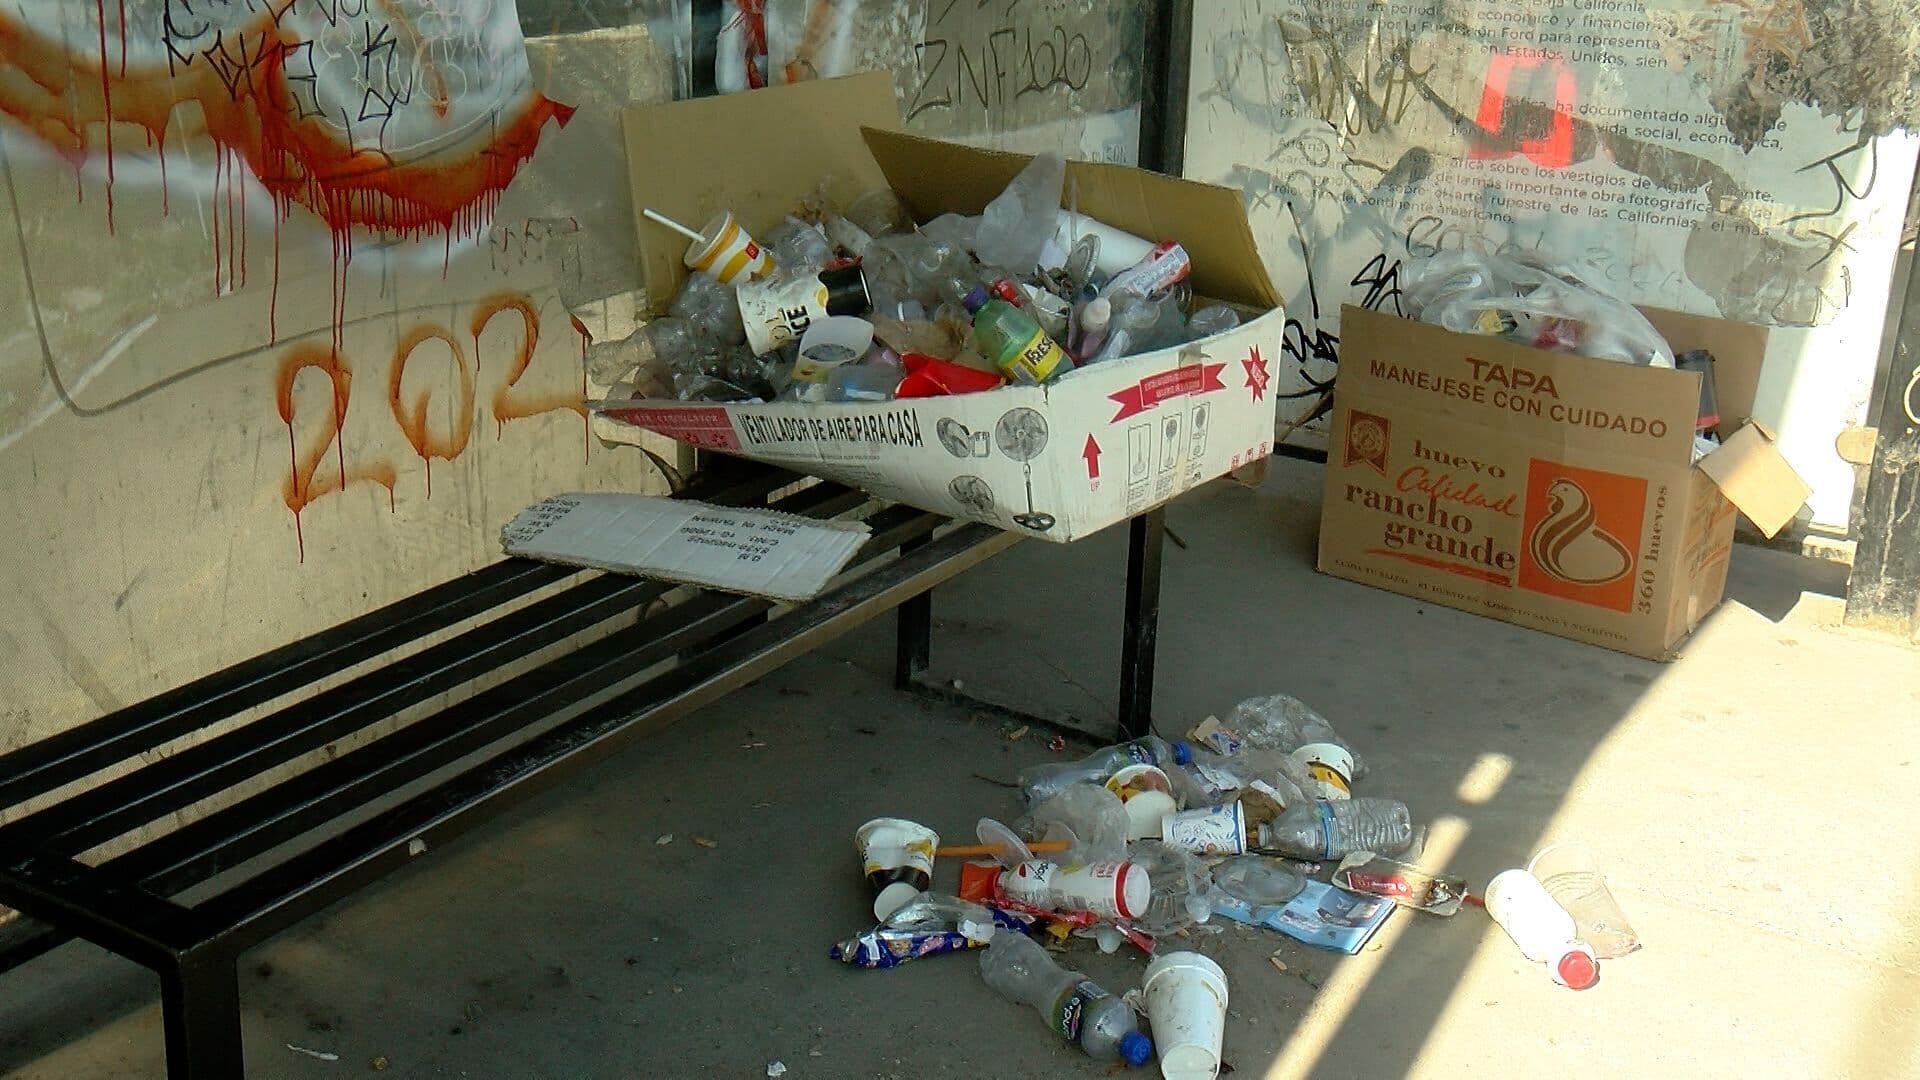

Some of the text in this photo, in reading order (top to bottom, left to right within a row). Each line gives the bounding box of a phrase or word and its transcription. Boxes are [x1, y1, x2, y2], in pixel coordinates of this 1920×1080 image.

[1567, 16, 1576, 28] y
[1573, 0, 1647, 13] California
[1501, 26, 1534, 40] Ford
[1538, 31, 1572, 45] para
[1480, 44, 1498, 54] en
[1506, 45, 1564, 61] Estados
[1571, 49, 1628, 67] Unidos,
[1556, 99, 1574, 112] ha
[1579, 103, 1689, 124] documentado
[1634, 126, 1682, 142] social,
[1489, 161, 1530, 176] sobre
[1535, 164, 1556, 179] los
[1560, 171, 1626, 187] vestigios
[1631, 177, 1652, 190] de
[1490, 196, 1552, 213] rupestre
[1560, 203, 1579, 216] de
[1588, 206, 1609, 219] las
[1617, 208, 1700, 230] Californias,
[1711, 220, 1725, 233] el
[1505, 178, 1588, 200] importante
[1591, 189, 1626, 204] obra
[1629, 191, 1713, 214] fotográfica
[1466, 356, 1560, 400] TAPA
[1369, 358, 1669, 439] MANEJESE CON CUIDADO
[736, 407, 924, 448] VENTILADOR DE AIRE PARA CASA
[1414, 439, 1506, 480] huevo
[1344, 481, 1474, 535] rancho
[1396, 465, 1521, 518] Calidad
[1383, 519, 1517, 573] grande
[1637, 485, 1668, 615] 360 huevos
